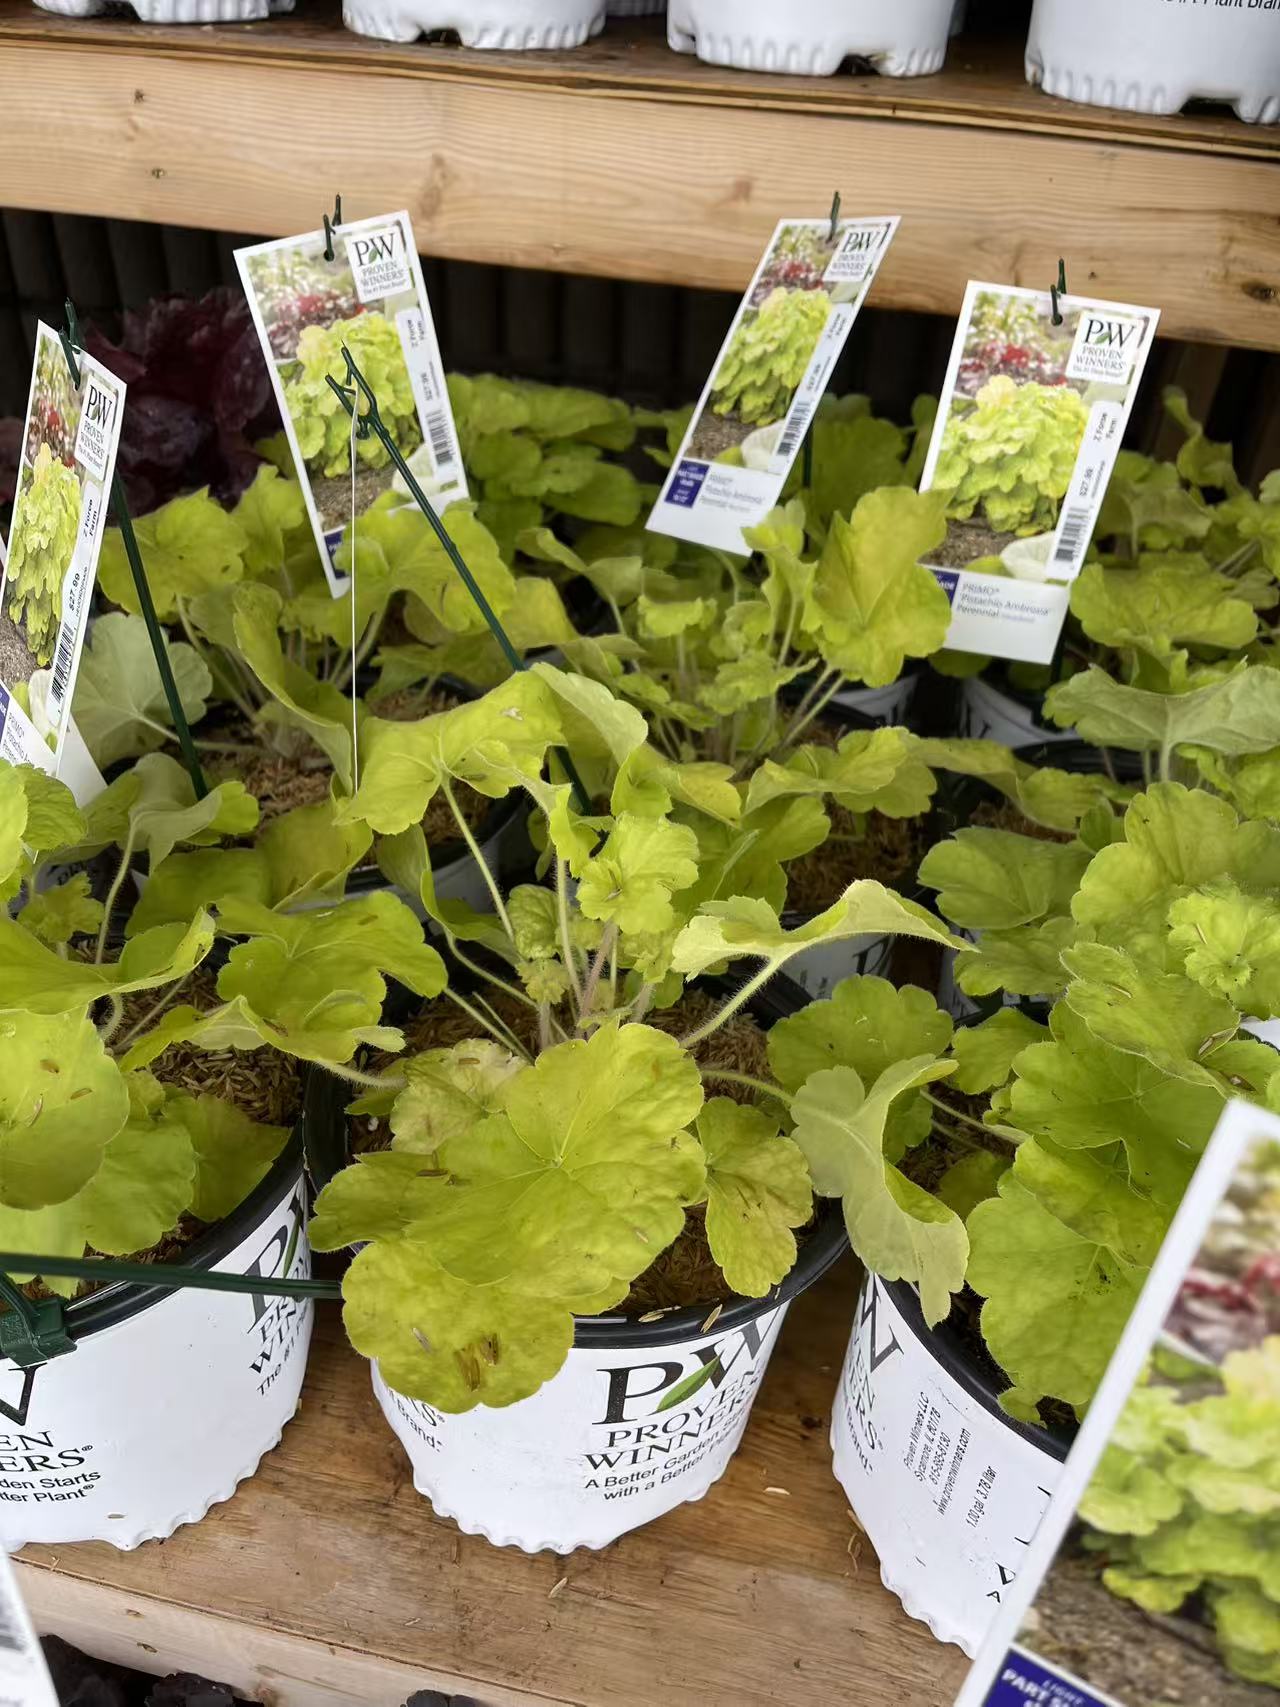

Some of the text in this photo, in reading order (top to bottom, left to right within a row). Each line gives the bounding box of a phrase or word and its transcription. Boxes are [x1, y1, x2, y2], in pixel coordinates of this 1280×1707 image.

[352, 232, 396, 267] PW
[842, 231, 880, 252] PW
[1082, 318, 1136, 348] PW
[1082, 345, 1124, 359] PROVEN
[85, 384, 113, 430] PW
[69, 572, 81, 612] $27.99
[256, 1363, 283, 1398] The
[591, 1305, 782, 1426] PW
[607, 1358, 761, 1448] PROVEN
[903, 1391, 930, 1470] Proven Winners LLC
[914, 1406, 942, 1482] Sycamore, IL 60178
[40, 1471, 101, 1490] Starts
[585, 1478, 599, 1489] A
[604, 1466, 660, 1488] Better
[663, 1430, 721, 1471] Garden
[603, 1484, 640, 1501] with
[644, 1481, 655, 1491] a
[661, 1452, 706, 1484] Better
[936, 1427, 972, 1516] www.provenwinners.com
[965, 1465, 998, 1528] 1.00 gal 3.78 liter
[1002, 1667, 1050, 1702] PART
